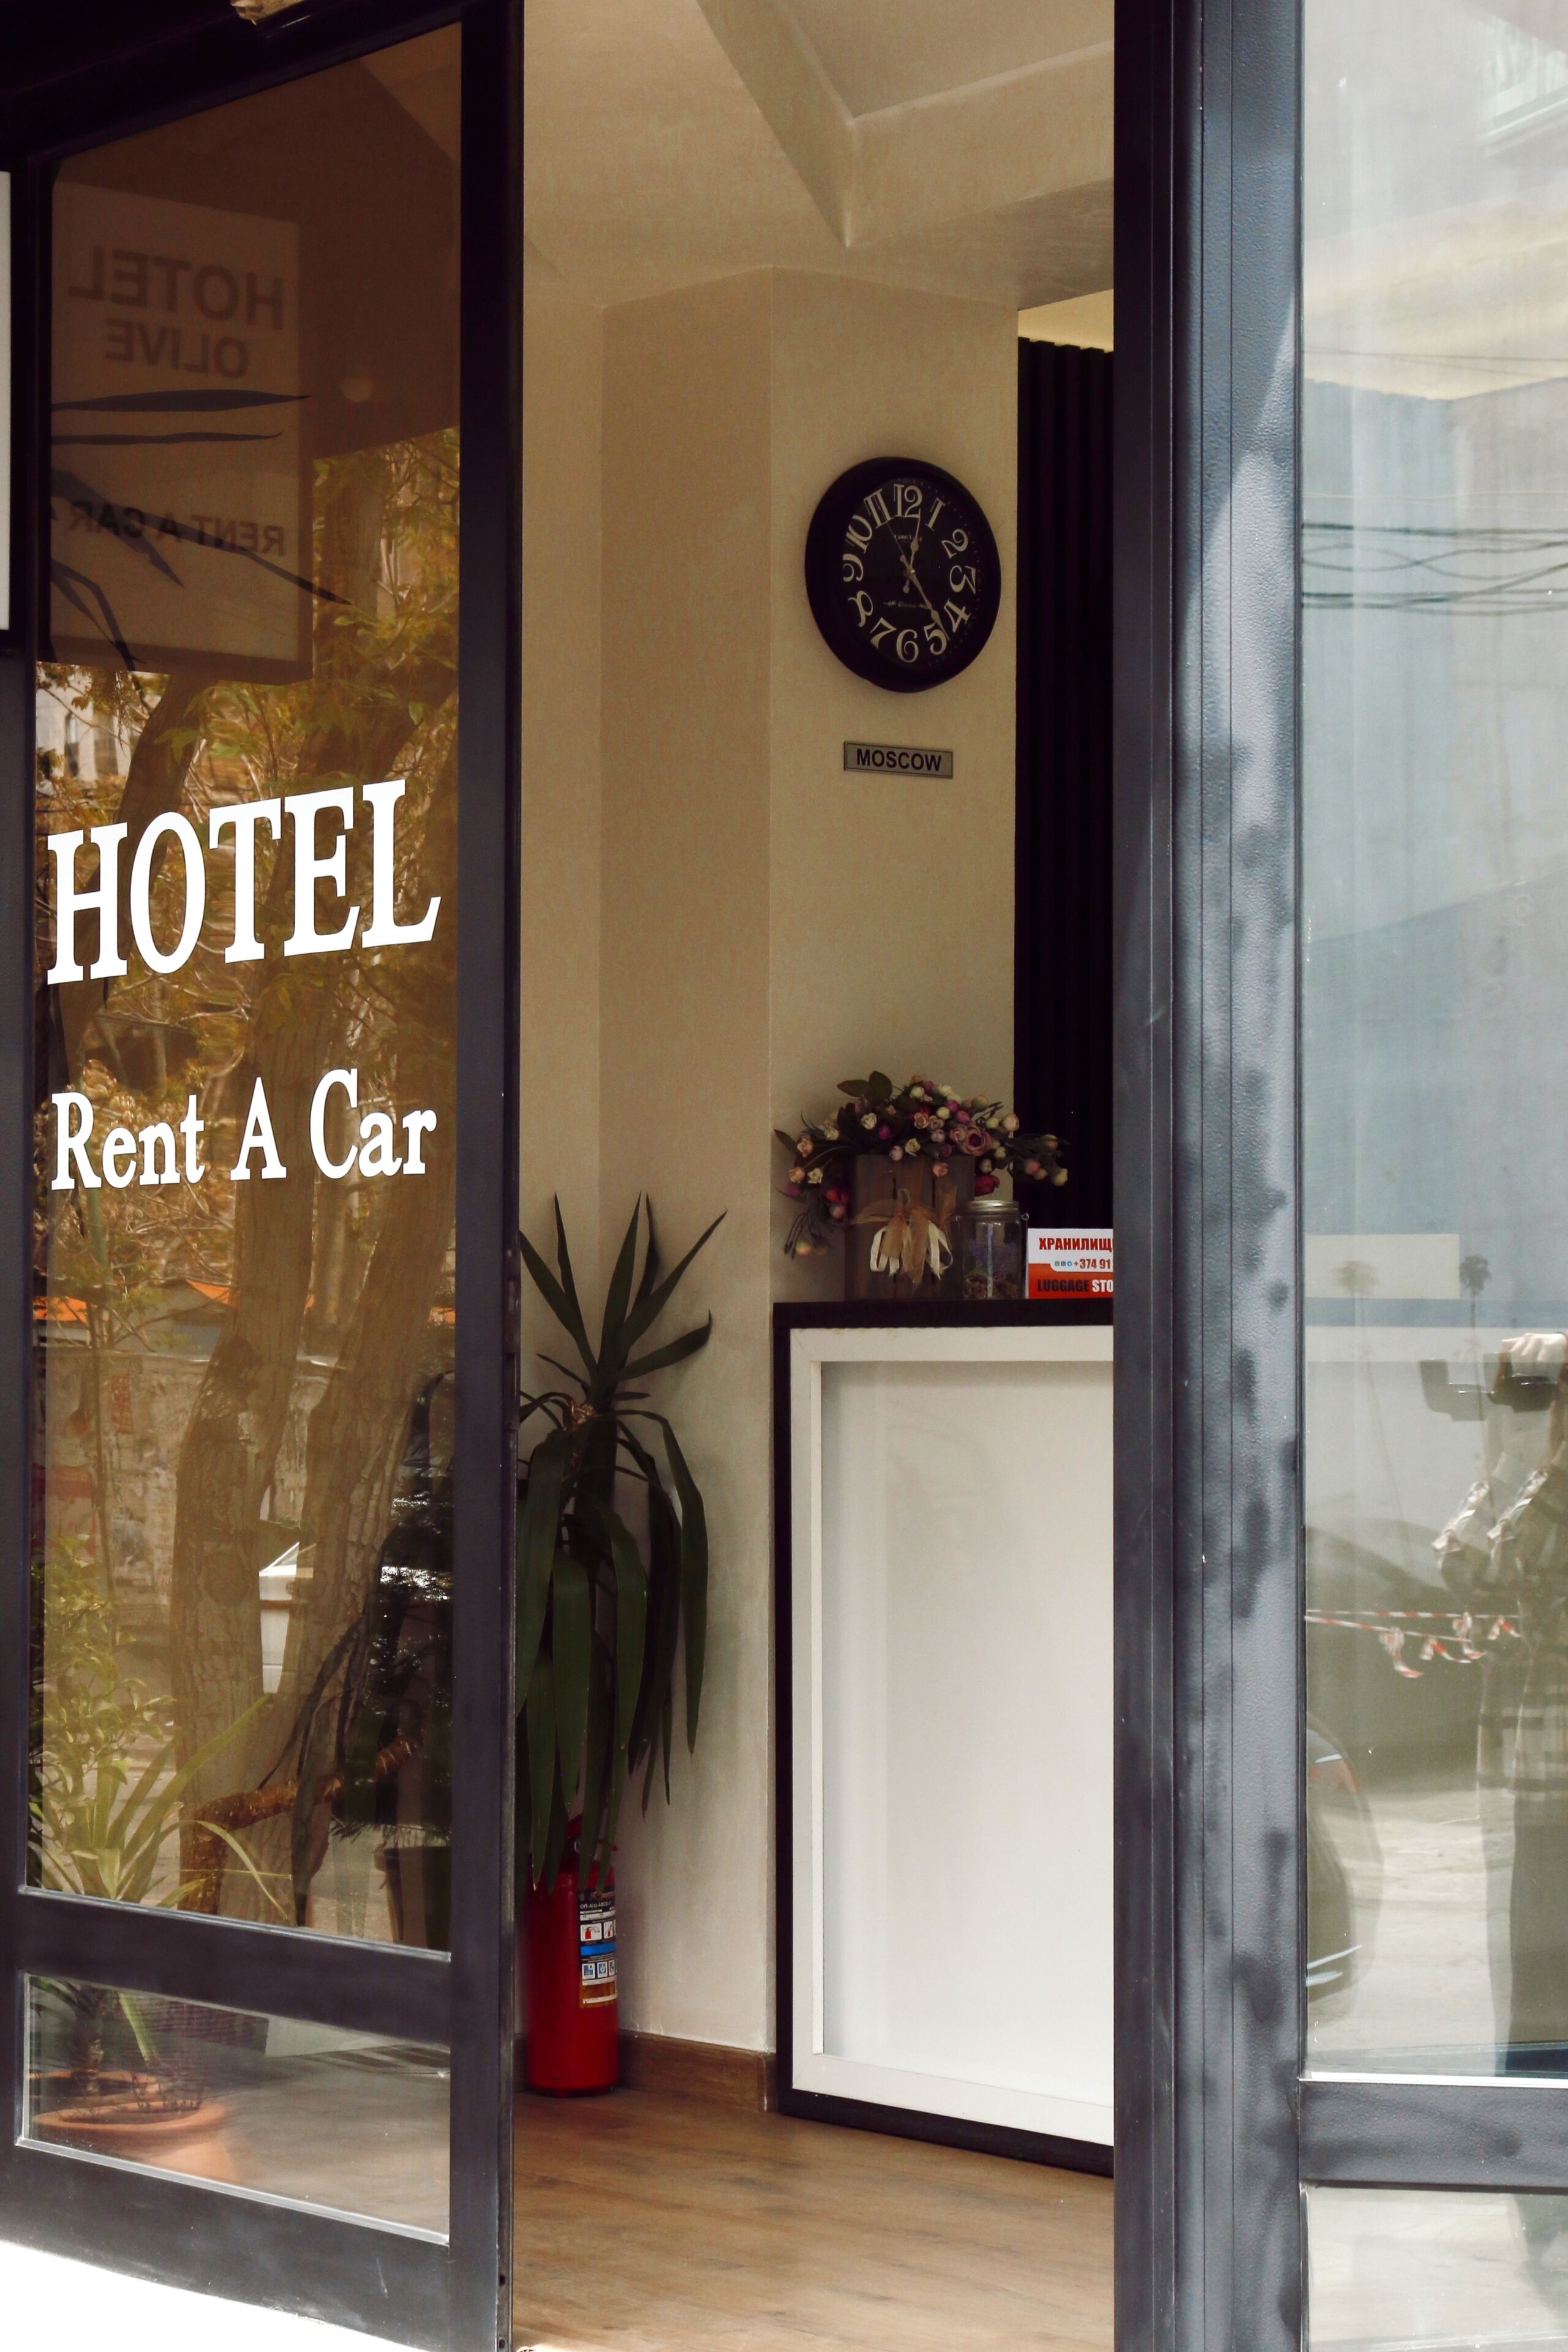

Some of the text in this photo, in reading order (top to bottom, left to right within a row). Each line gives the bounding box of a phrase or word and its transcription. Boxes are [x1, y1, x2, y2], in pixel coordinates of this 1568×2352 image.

[893, 483, 923, 519] 12
[924, 497, 946, 532] 1
[845, 514, 873, 554] 10
[941, 528, 970, 559] 2
[842, 553, 864, 582] 9
[949, 565, 977, 595] 3
[943, 598, 971, 633] 4
[869, 617, 897, 649] 7
[895, 628, 919, 663] 6
[923, 621, 948, 656] 5
[857, 748, 942, 772] MOSCOW
[47, 778, 442, 986] HOTEL
[51, 1068, 439, 1191] Rent A Car
[1039, 1237, 1114, 1253] ХРАНИЛИЩ
[1099, 1259, 1111, 1270] 91
[1037, 1279, 1090, 1292] LUGGAGE
